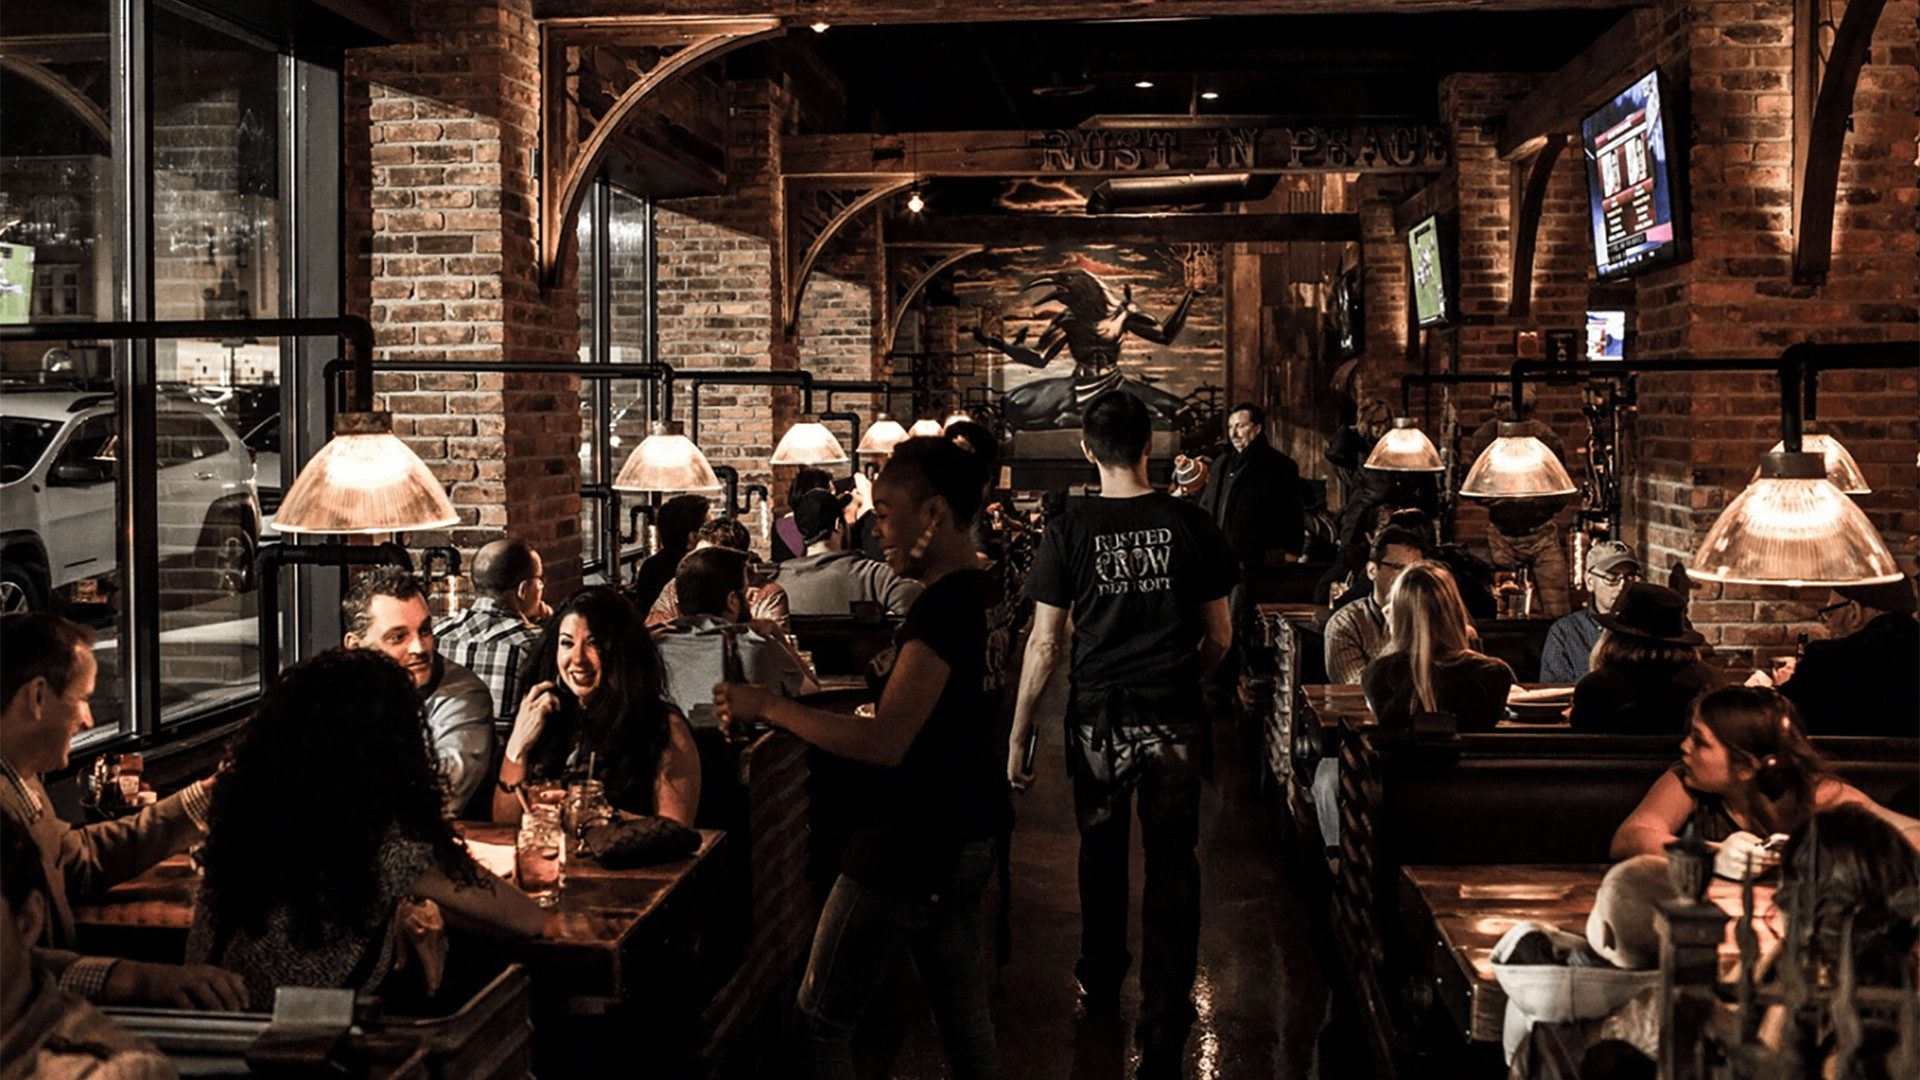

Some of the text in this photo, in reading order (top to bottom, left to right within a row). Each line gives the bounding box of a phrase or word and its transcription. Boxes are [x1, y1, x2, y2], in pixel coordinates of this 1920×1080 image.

[1040, 126, 1450, 170] RUST IN PEACE
[1095, 528, 1172, 552] RUSTED
[1096, 545, 1173, 582] CROW
